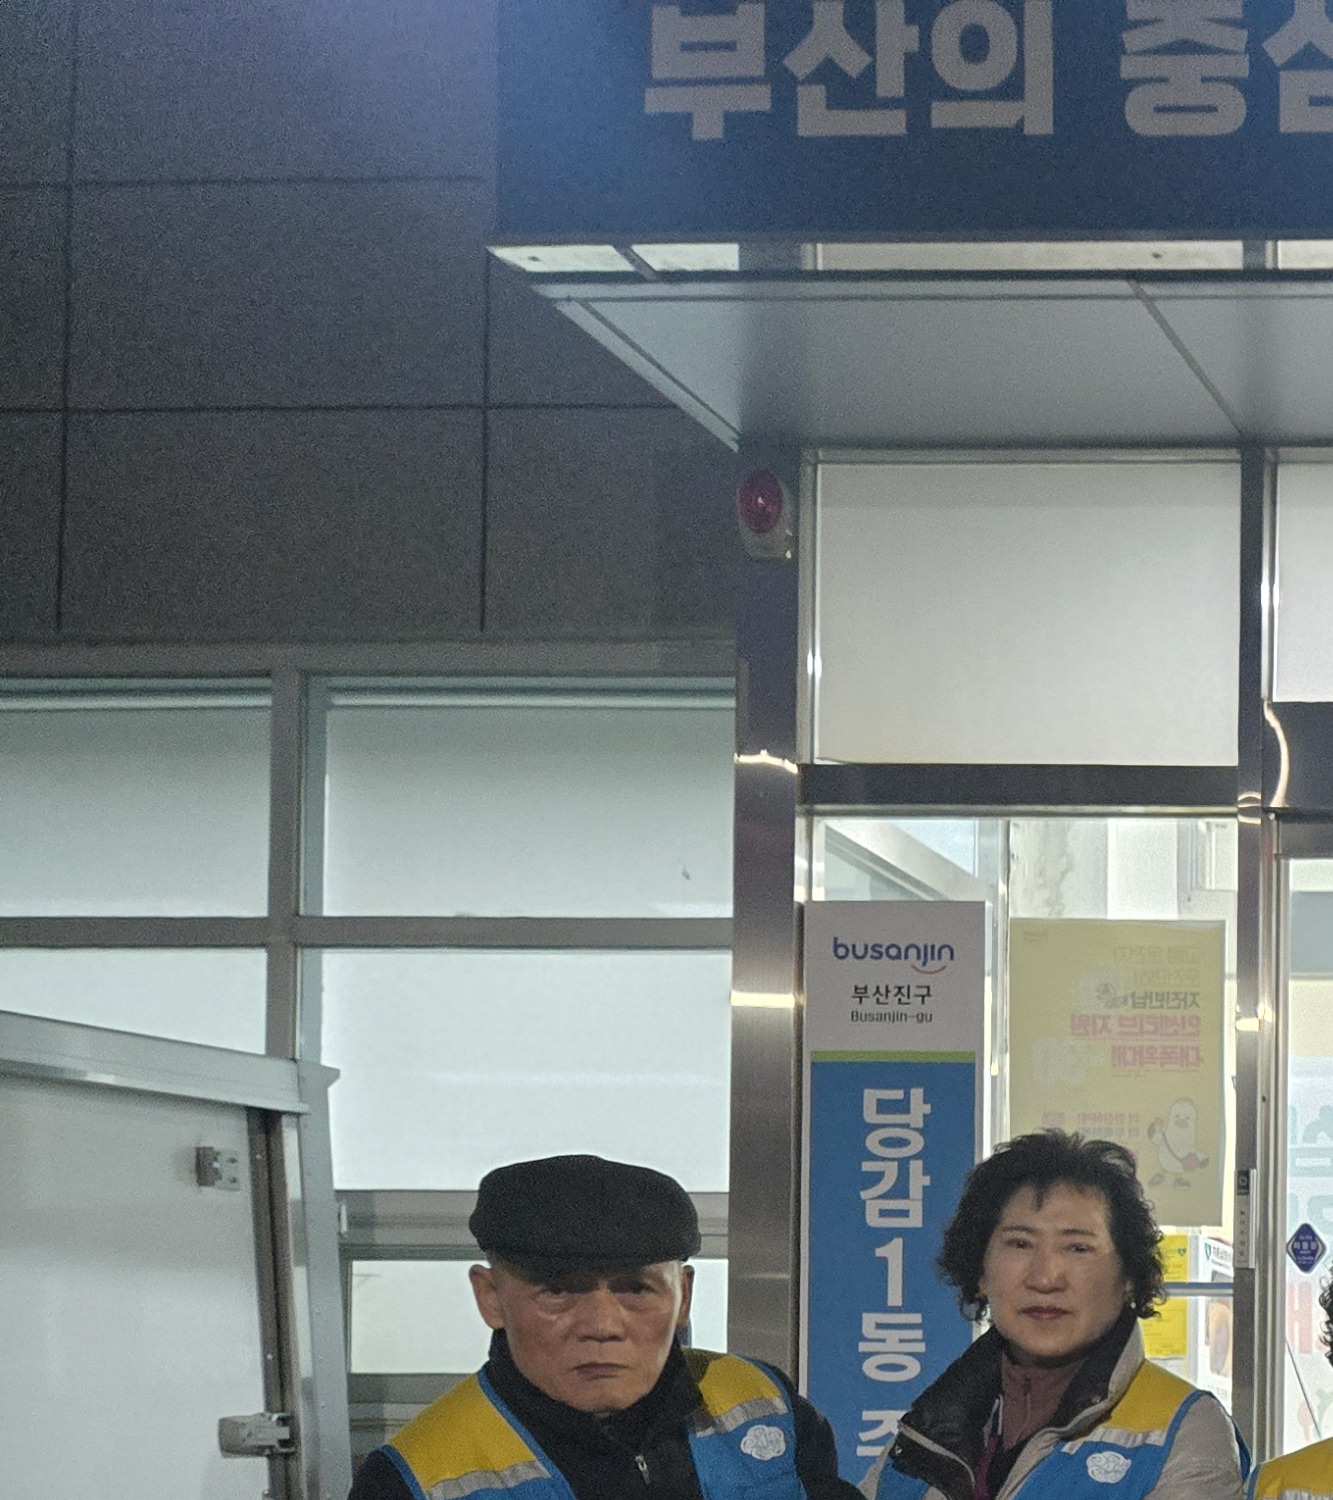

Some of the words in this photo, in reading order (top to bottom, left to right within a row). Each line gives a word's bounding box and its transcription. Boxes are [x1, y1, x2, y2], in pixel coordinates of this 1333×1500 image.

[643, 0, 1055, 141] 부산의
[832, 936, 955, 967] busanjin
[851, 984, 932, 1005] 부산진구
[850, 1010, 933, 1024] Busanjin-gu
[858, 1086, 932, 1383] 당감1동
